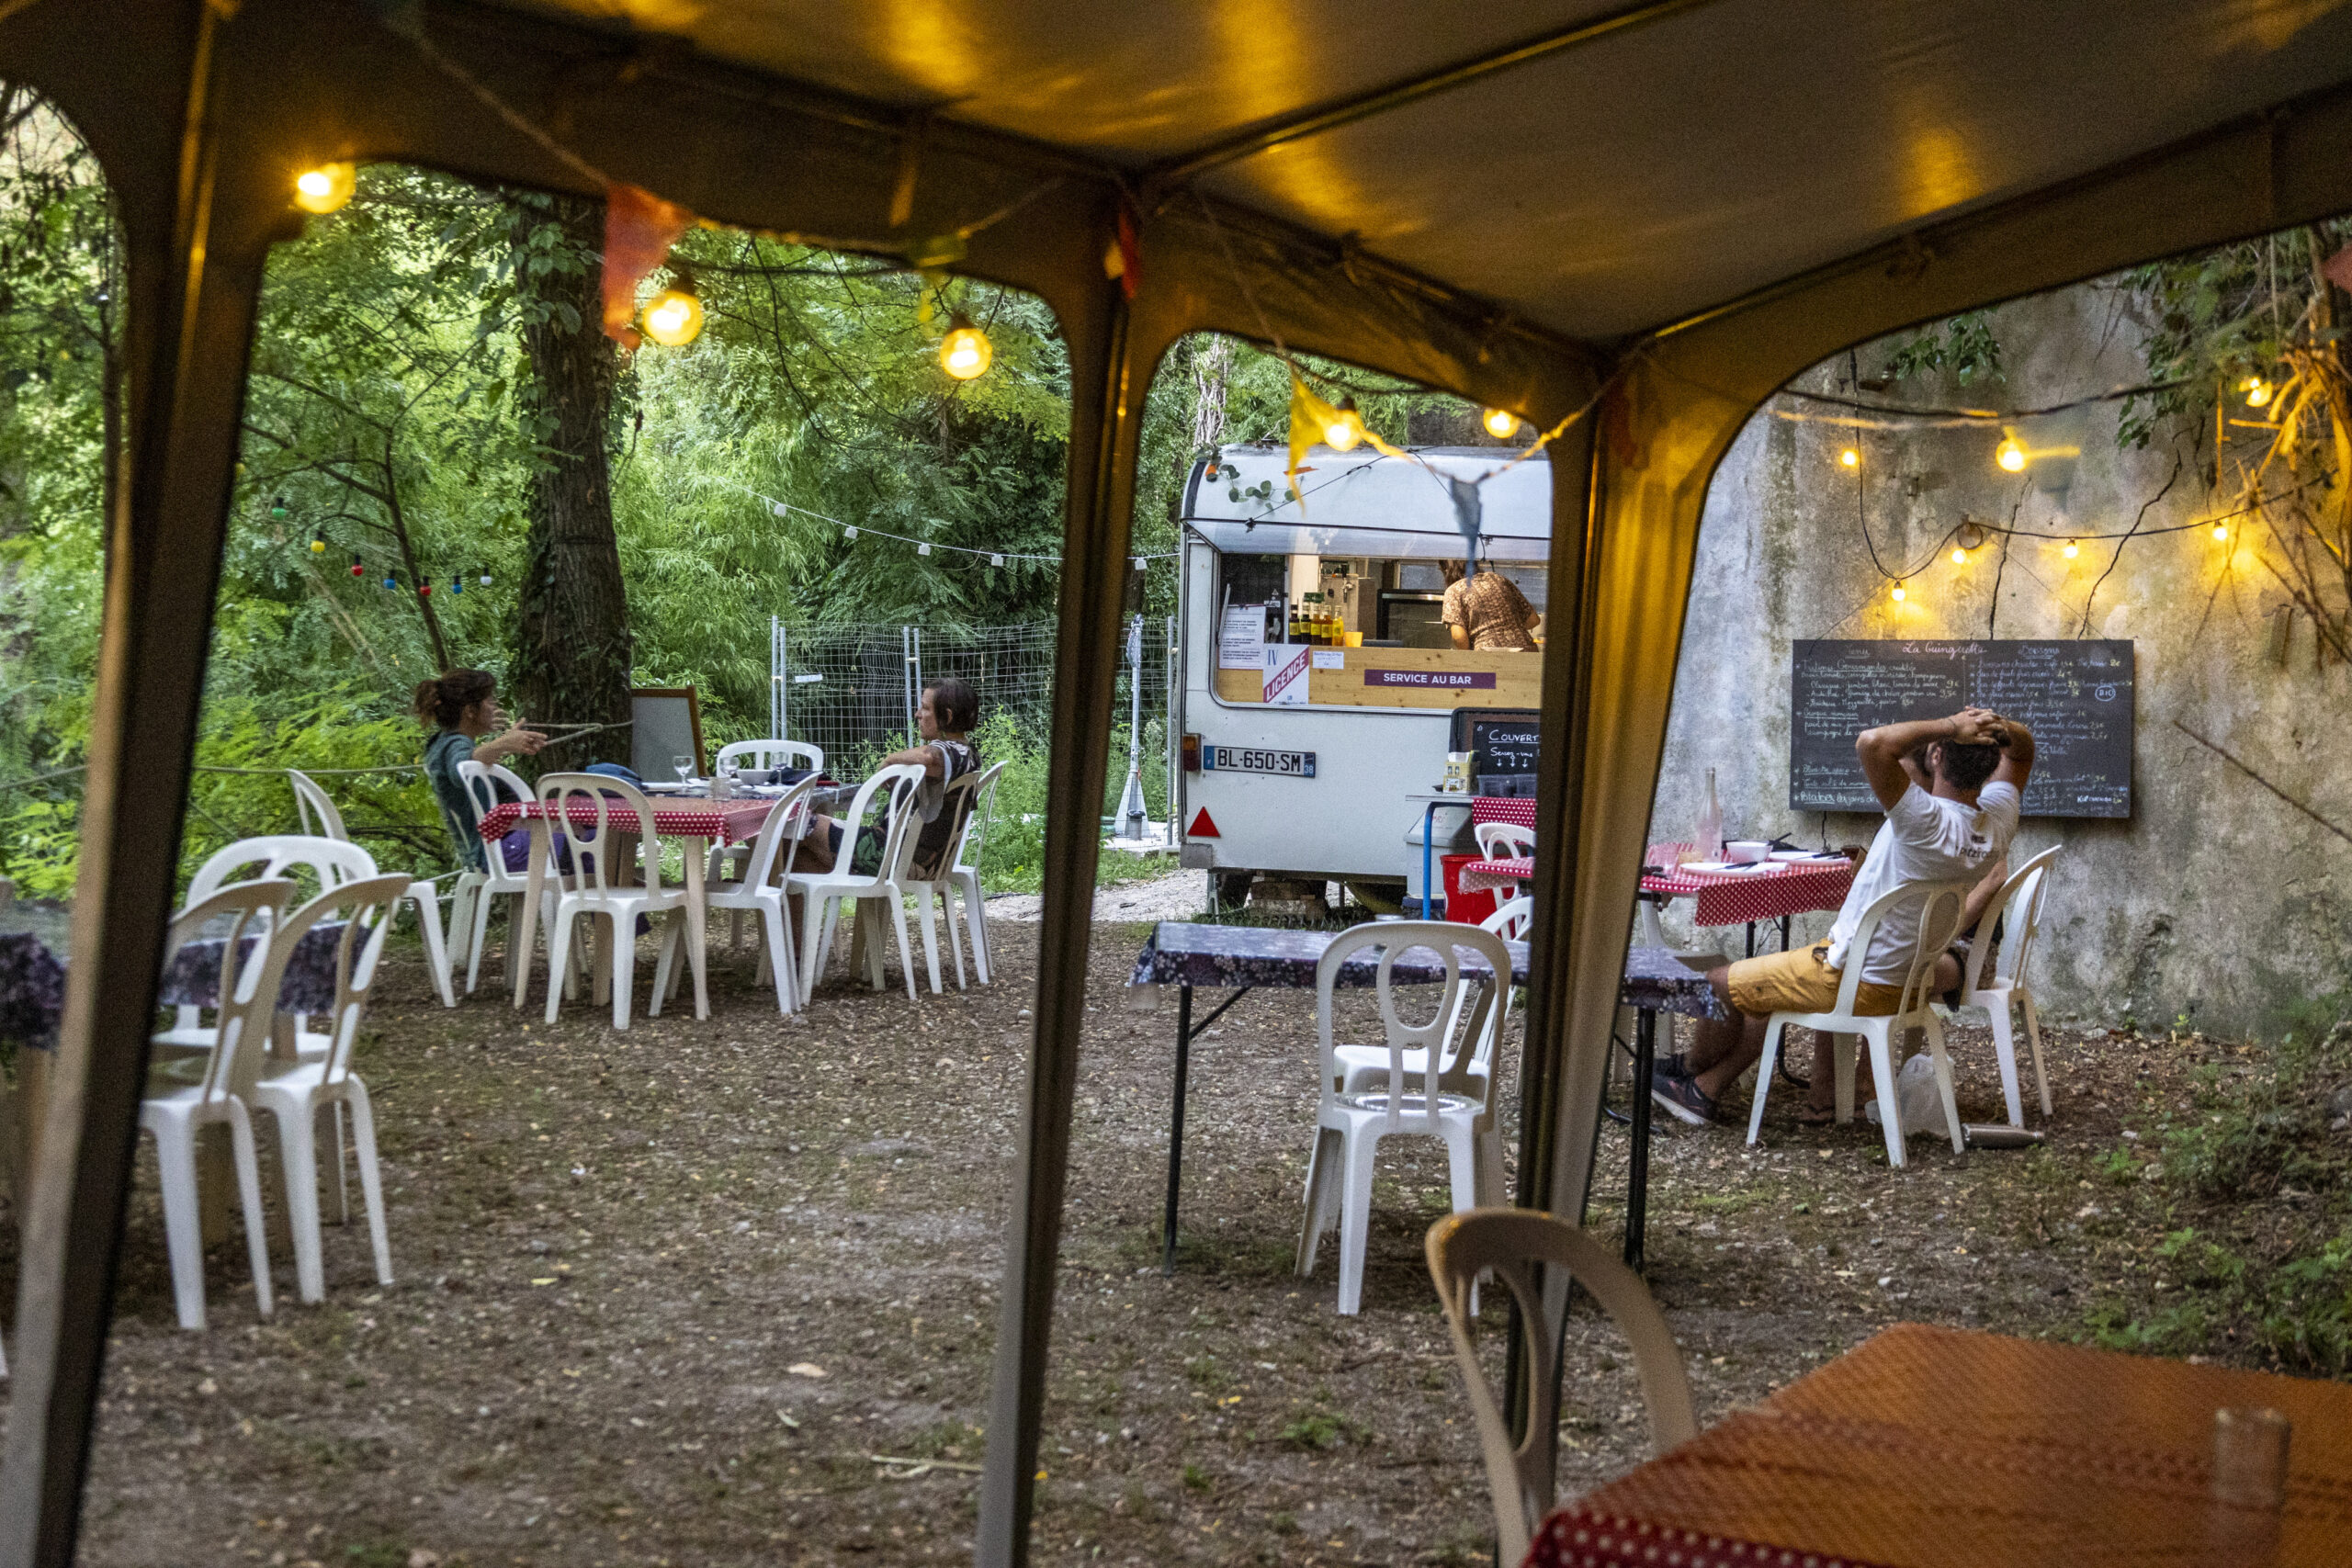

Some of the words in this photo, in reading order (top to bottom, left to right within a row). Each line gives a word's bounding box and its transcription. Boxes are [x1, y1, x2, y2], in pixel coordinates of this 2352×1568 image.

[1267, 649, 1279, 666] IV
[1266, 653, 1306, 704] LICENCE
[1383, 672, 1428, 683] SERVICE
[1431, 675, 1447, 684] AU
[1449, 675, 1472, 685] BAR
[1488, 729, 1542, 742] COUVERT
[1217, 749, 1301, 773] BL-650-SM
[1304, 764, 1315, 774] 38
